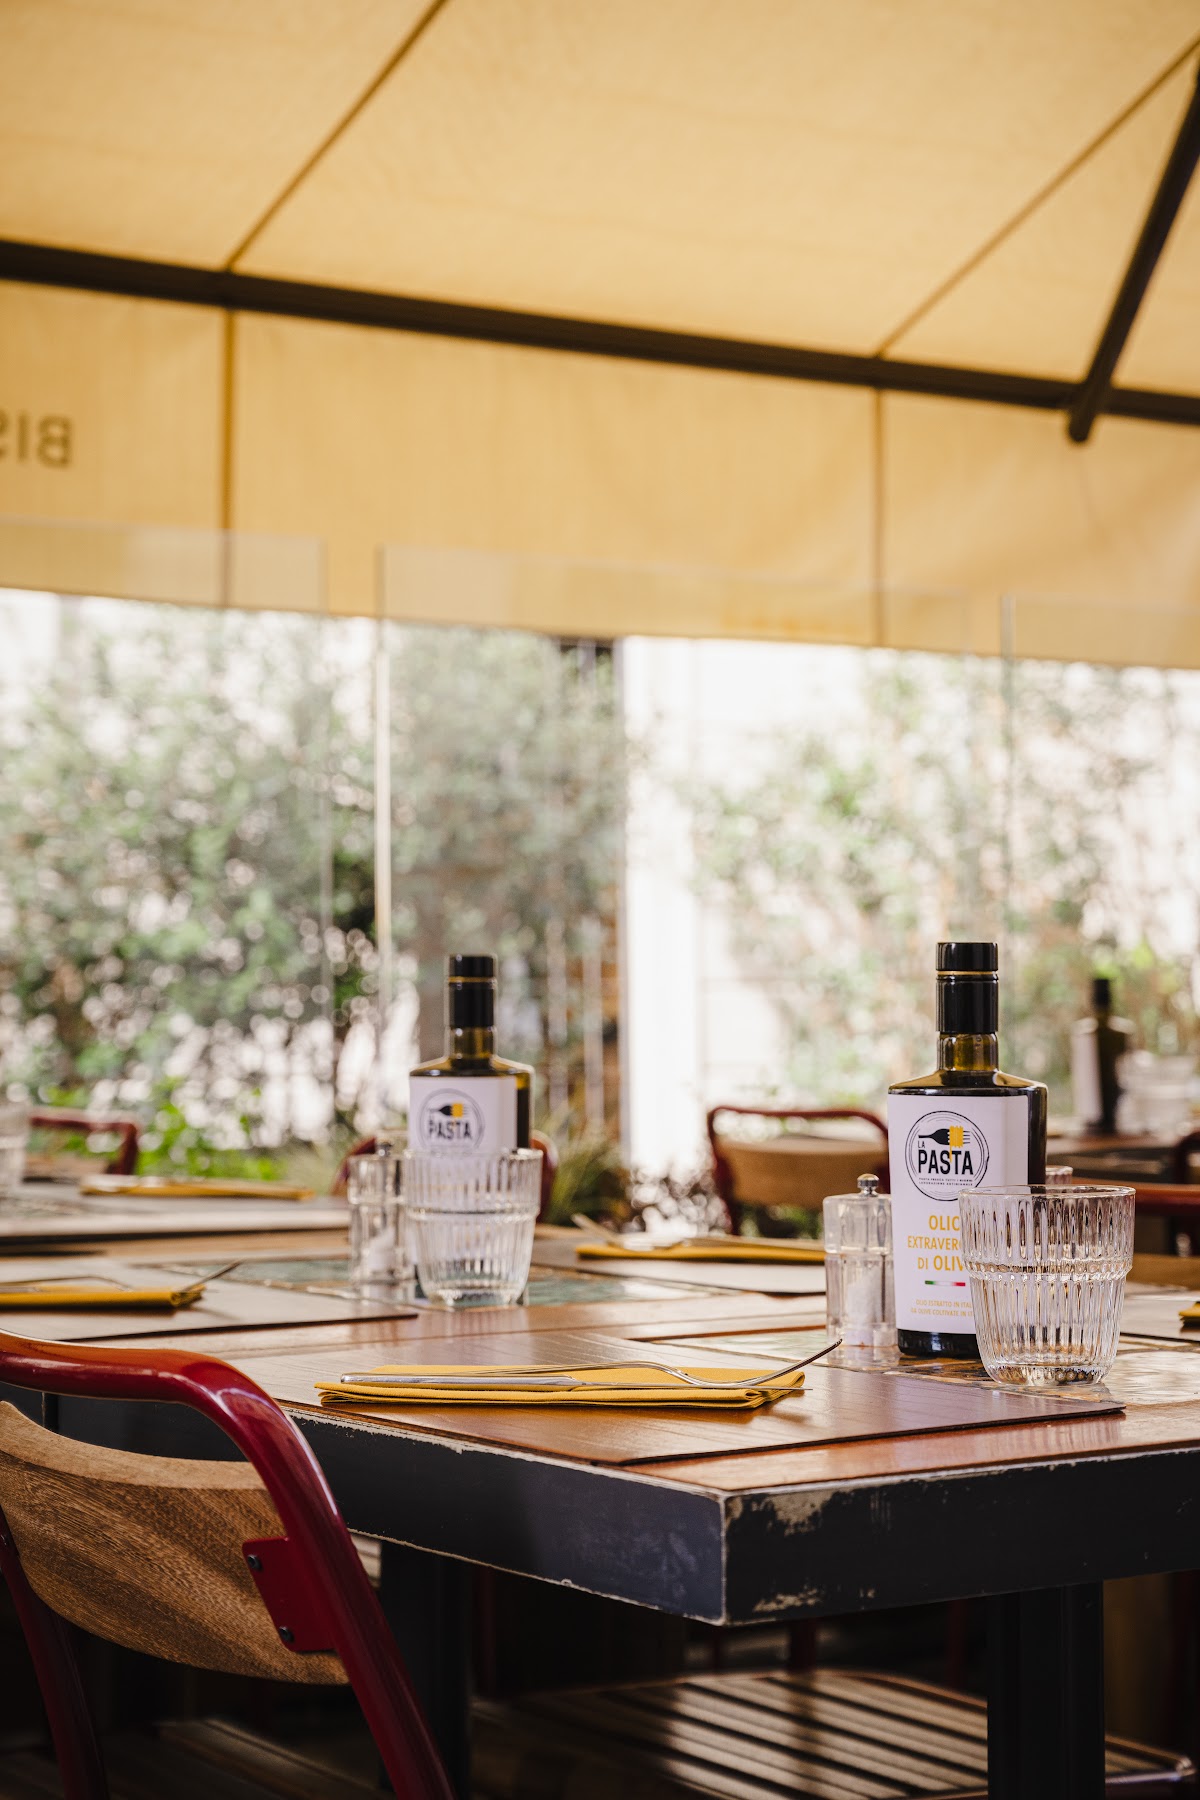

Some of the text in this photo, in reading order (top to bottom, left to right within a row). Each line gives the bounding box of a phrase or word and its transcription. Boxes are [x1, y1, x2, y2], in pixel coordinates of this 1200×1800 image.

[428, 1119, 473, 1140] PASTA
[917, 1140, 926, 1149] LA
[918, 1149, 974, 1175] PASTA
[907, 1235, 962, 1251] EXTRAVER
[917, 1256, 929, 1270] DI
